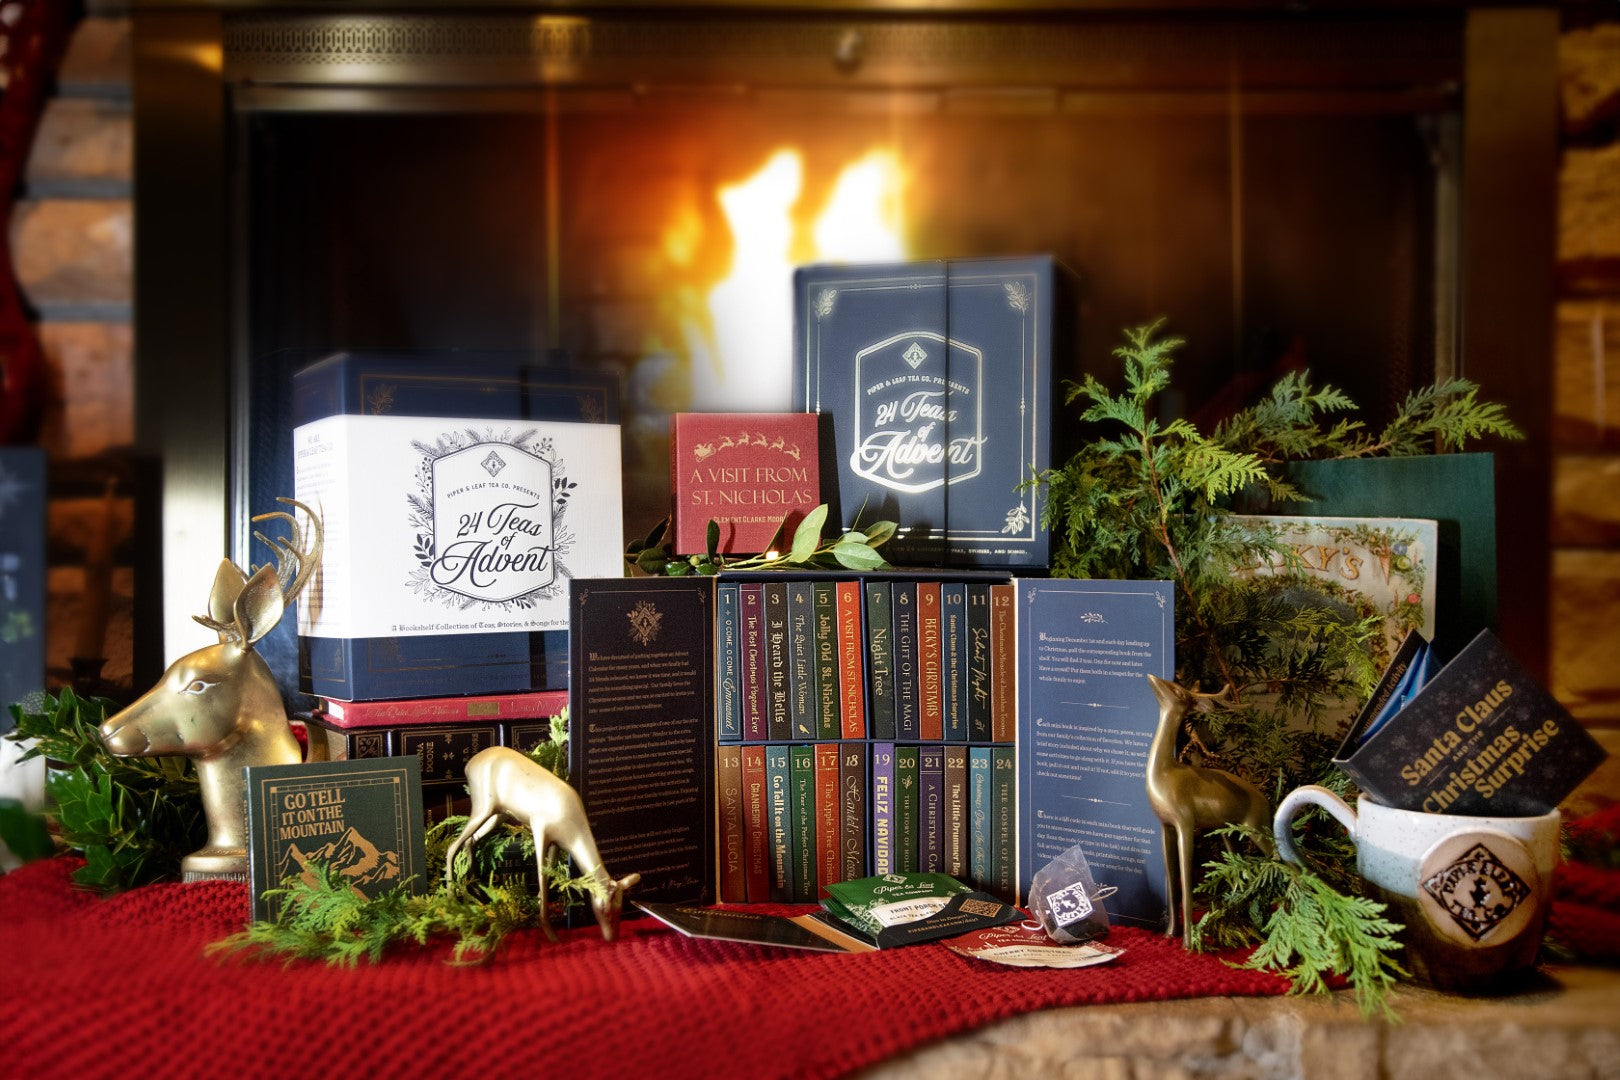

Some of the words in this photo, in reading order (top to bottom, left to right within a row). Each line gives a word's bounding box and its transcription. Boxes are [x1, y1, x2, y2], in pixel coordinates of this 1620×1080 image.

[867, 383, 884, 395] PIPER
[892, 376, 906, 385] LEAF
[875, 401, 898, 427] 24
[917, 422, 935, 440] of
[850, 430, 988, 478] Advent
[690, 469, 702, 483] A
[709, 468, 750, 483] VISIT
[756, 468, 807, 482] FROM
[447, 488, 464, 499] PIPER
[513, 485, 540, 500] PRESENTS
[692, 490, 713, 505] ST.
[719, 489, 812, 504] NICHOLAS
[457, 511, 482, 538] 24
[487, 502, 542, 537] Teas
[500, 532, 516, 550] of
[430, 539, 560, 588] Advent
[725, 594, 730, 604] 1
[748, 594, 756, 605] 2
[772, 594, 779, 604] 3
[796, 593, 804, 604] 4
[819, 593, 828, 604] 5
[844, 592, 852, 603] 6
[874, 593, 881, 604] 7
[900, 592, 908, 605] 8
[926, 594, 934, 606] 9
[947, 594, 961, 605] 10
[972, 595, 985, 605] 11
[994, 596, 1009, 607] 12
[436, 623, 470, 631] Collection
[748, 615, 757, 629] The
[795, 615, 805, 632] The
[818, 614, 830, 639] Jolly
[845, 618, 854, 639] VISIT
[901, 613, 909, 632] THE
[749, 631, 757, 647] Best
[794, 634, 805, 656] Quiet
[871, 628, 886, 665] Night
[925, 618, 936, 658] BECKY'S
[770, 633, 783, 668] Heard
[821, 642, 831, 661] Old
[846, 642, 854, 669] FROM
[901, 636, 910, 660] GIFT
[749, 649, 758, 684] Christmas
[797, 659, 806, 680] Little
[821, 667, 832, 680] St.
[902, 662, 911, 676] OF
[772, 672, 784, 688] the
[875, 667, 888, 696] Tree
[926, 662, 938, 717] CHRISTMAS
[798, 682, 807, 715] Woman
[902, 680, 911, 700] THE
[722, 678, 736, 731] Emmanuel
[748, 685, 759, 715] Pageant
[774, 691, 785, 723] Bells
[822, 683, 833, 729] Nicholas
[848, 684, 857, 733] NICHOLAS
[752, 716, 760, 734] Ever
[903, 704, 912, 731] MAGI
[1400, 731, 1462, 786] Santa
[1456, 679, 1514, 734] Claus
[1452, 748, 1470, 762] AND
[1468, 730, 1484, 749] THE
[724, 757, 739, 768] 13
[747, 757, 762, 767] 14
[770, 757, 785, 768] 15
[795, 757, 810, 768] 16
[821, 755, 836, 766] 17
[846, 754, 858, 767] 18
[875, 754, 890, 766] 19
[899, 758, 915, 769] 20
[925, 757, 939, 768] 21
[948, 758, 963, 769] 22
[972, 758, 988, 769] 23
[996, 758, 1012, 769] 24
[1423, 724, 1521, 813] Christmas
[1474, 719, 1560, 799] Surprise
[773, 775, 783, 788] Go
[825, 782, 834, 799] The
[284, 793, 306, 810] GO
[309, 789, 346, 806] TELL
[773, 789, 784, 806] Tell
[877, 776, 888, 813] FELIZ
[952, 784, 960, 799] The
[726, 788, 737, 832] SANTA
[824, 800, 834, 826] Apple
[846, 775, 860, 834] Handel's
[952, 800, 961, 821] Little
[282, 812, 296, 826] IT
[297, 810, 316, 824] ON
[318, 805, 344, 820] THE
[775, 816, 781, 826] on
[928, 794, 937, 850] CHRISTMAS
[280, 820, 344, 841] MOUNTAIN
[776, 828, 785, 843] the
[826, 828, 834, 848] Tree
[878, 819, 889, 876] NAVIDAD
[952, 822, 961, 861] Drummer
[727, 834, 738, 873] LUCIA
[752, 831, 762, 874] CHRISTMAS
[846, 838, 860, 882] Messia
[776, 845, 786, 889] Mountain
[826, 850, 834, 884] Christm
[928, 854, 938, 874] CAR
[952, 862, 961, 876] Boy
